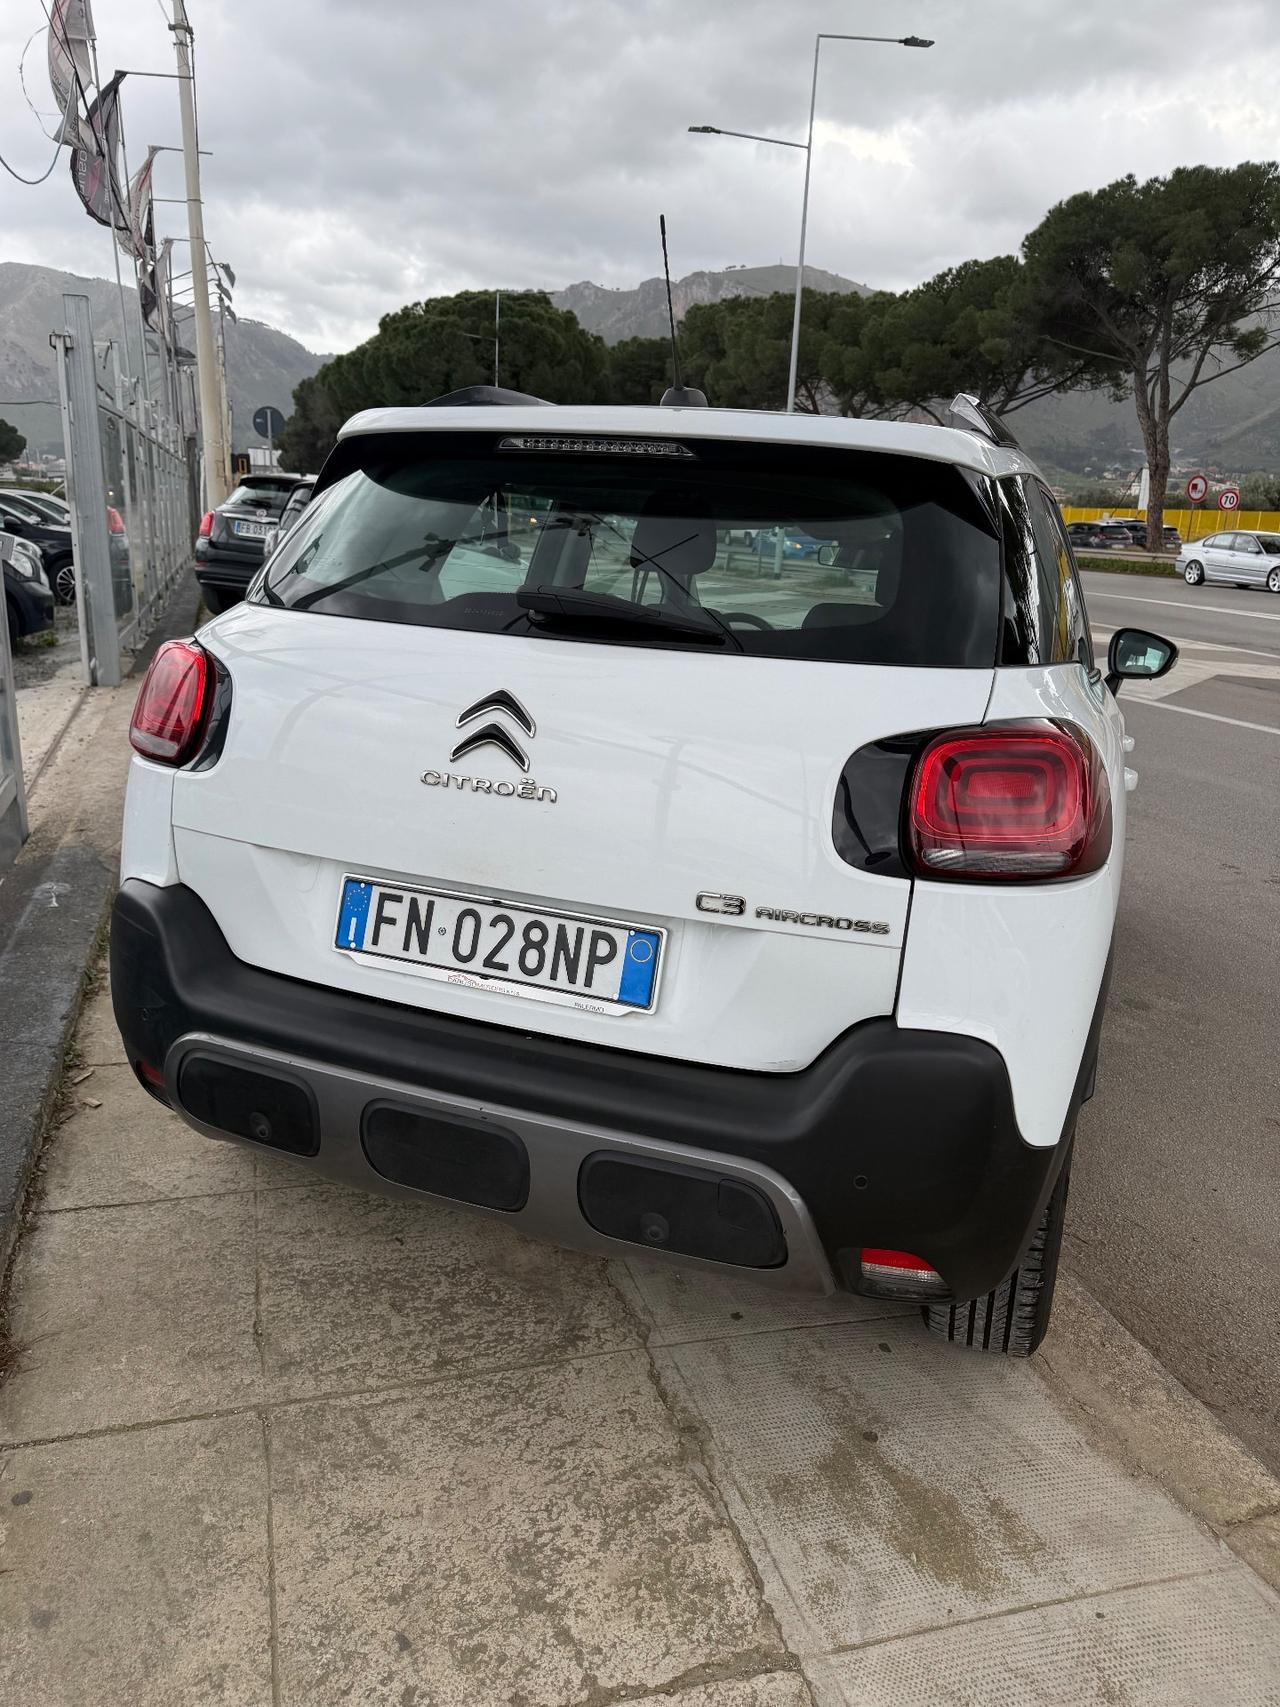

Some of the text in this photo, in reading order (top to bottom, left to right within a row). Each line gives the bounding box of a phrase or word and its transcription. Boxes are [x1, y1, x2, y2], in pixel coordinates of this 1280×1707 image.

[1224, 495, 1235, 505] 70
[695, 891, 891, 935] C3 AIRCROSS
